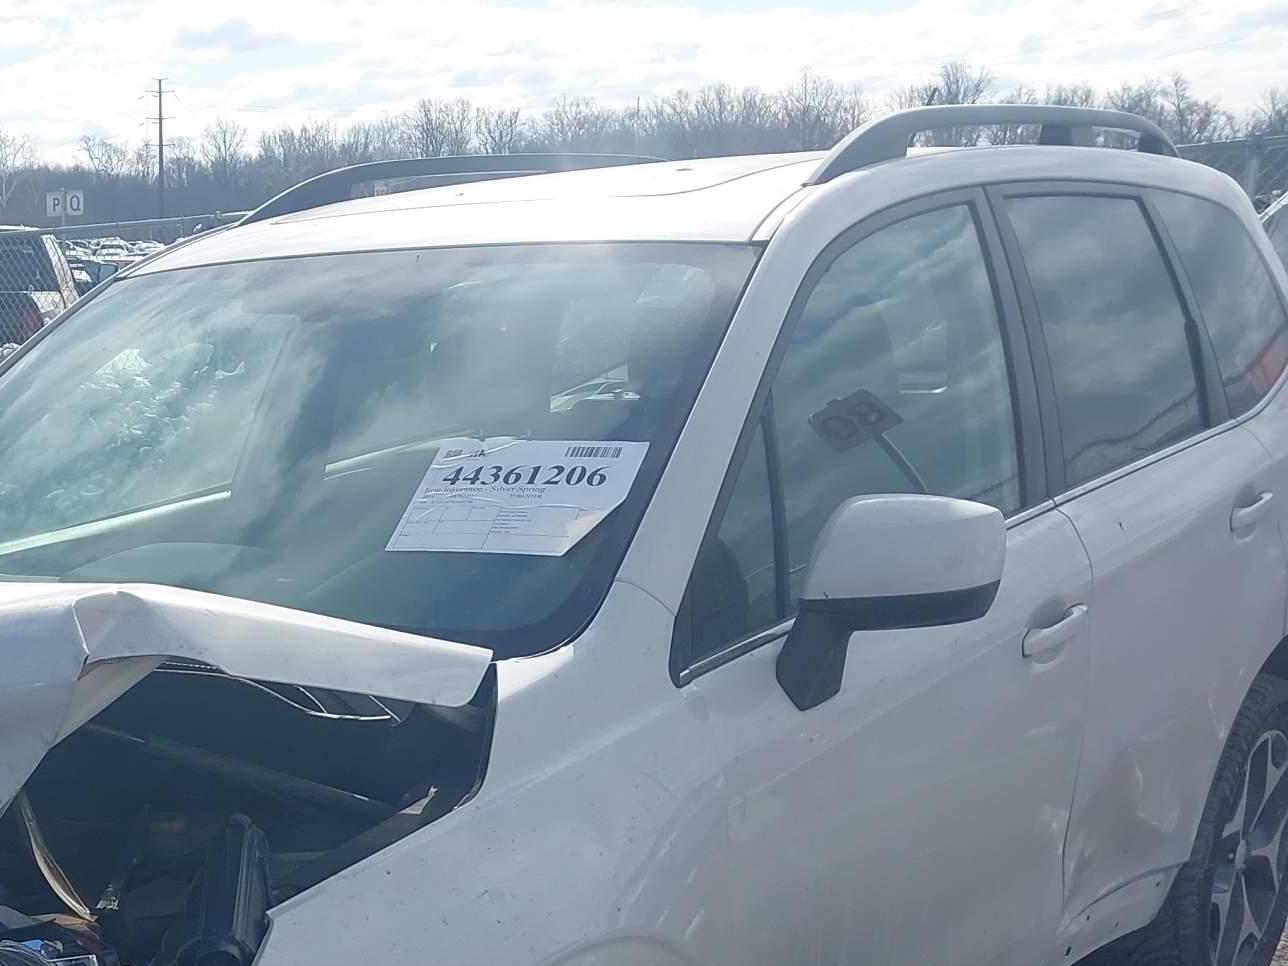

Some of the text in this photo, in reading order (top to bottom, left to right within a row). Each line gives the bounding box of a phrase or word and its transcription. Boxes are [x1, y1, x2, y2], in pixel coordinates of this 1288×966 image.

[52, 197, 60, 212] P
[69, 194, 82, 212] Q
[442, 465, 609, 487] 44361206
[490, 485, 517, 493] Silver
[518, 485, 546, 494] Spring
